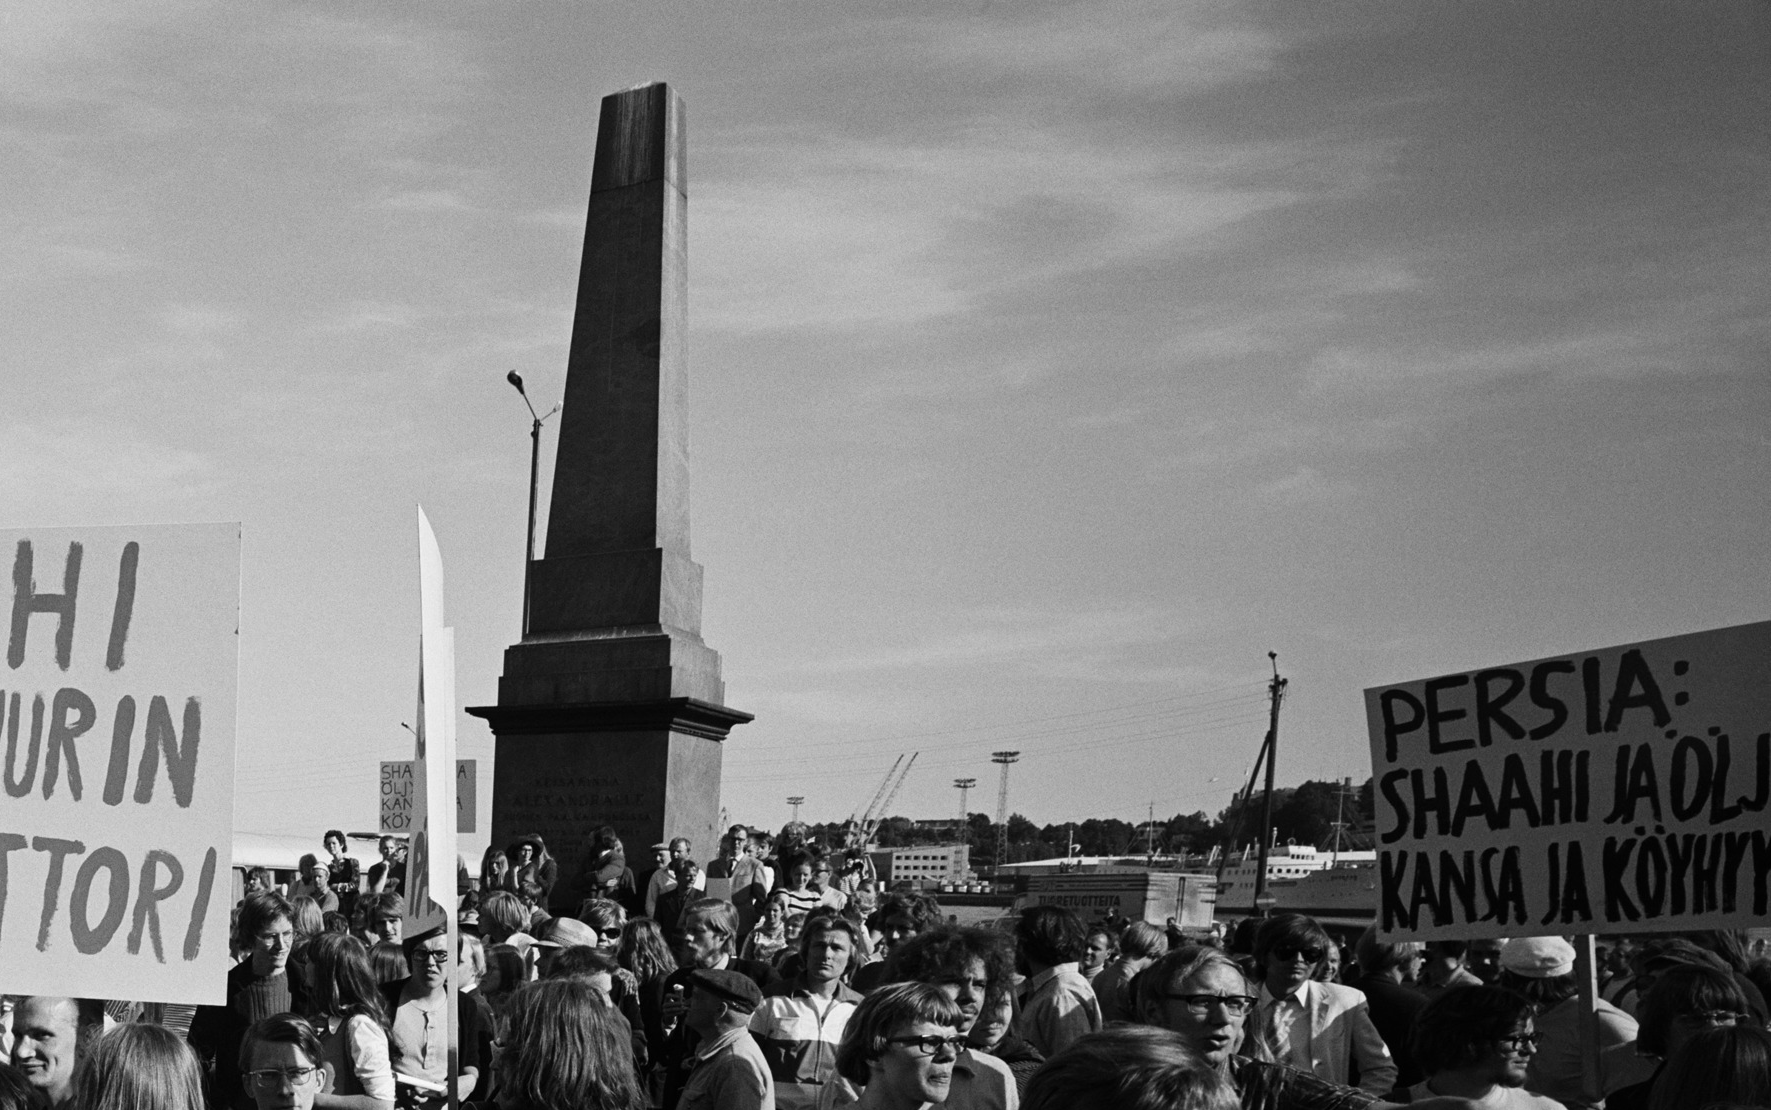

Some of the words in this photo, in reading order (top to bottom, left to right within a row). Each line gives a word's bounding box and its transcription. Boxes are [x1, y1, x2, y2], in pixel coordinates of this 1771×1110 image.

[1379, 648, 1690, 763] PERSIA:
[381, 764, 413, 779] SHA
[457, 764, 467, 779] A
[1379, 749, 1591, 844] SHAAHI
[1603, 742, 1663, 825] JA
[381, 797, 413, 811] KAN
[381, 812, 412, 829] KÖY
[1380, 846, 1528, 933] KANSA
[1541, 840, 1593, 927] JA
